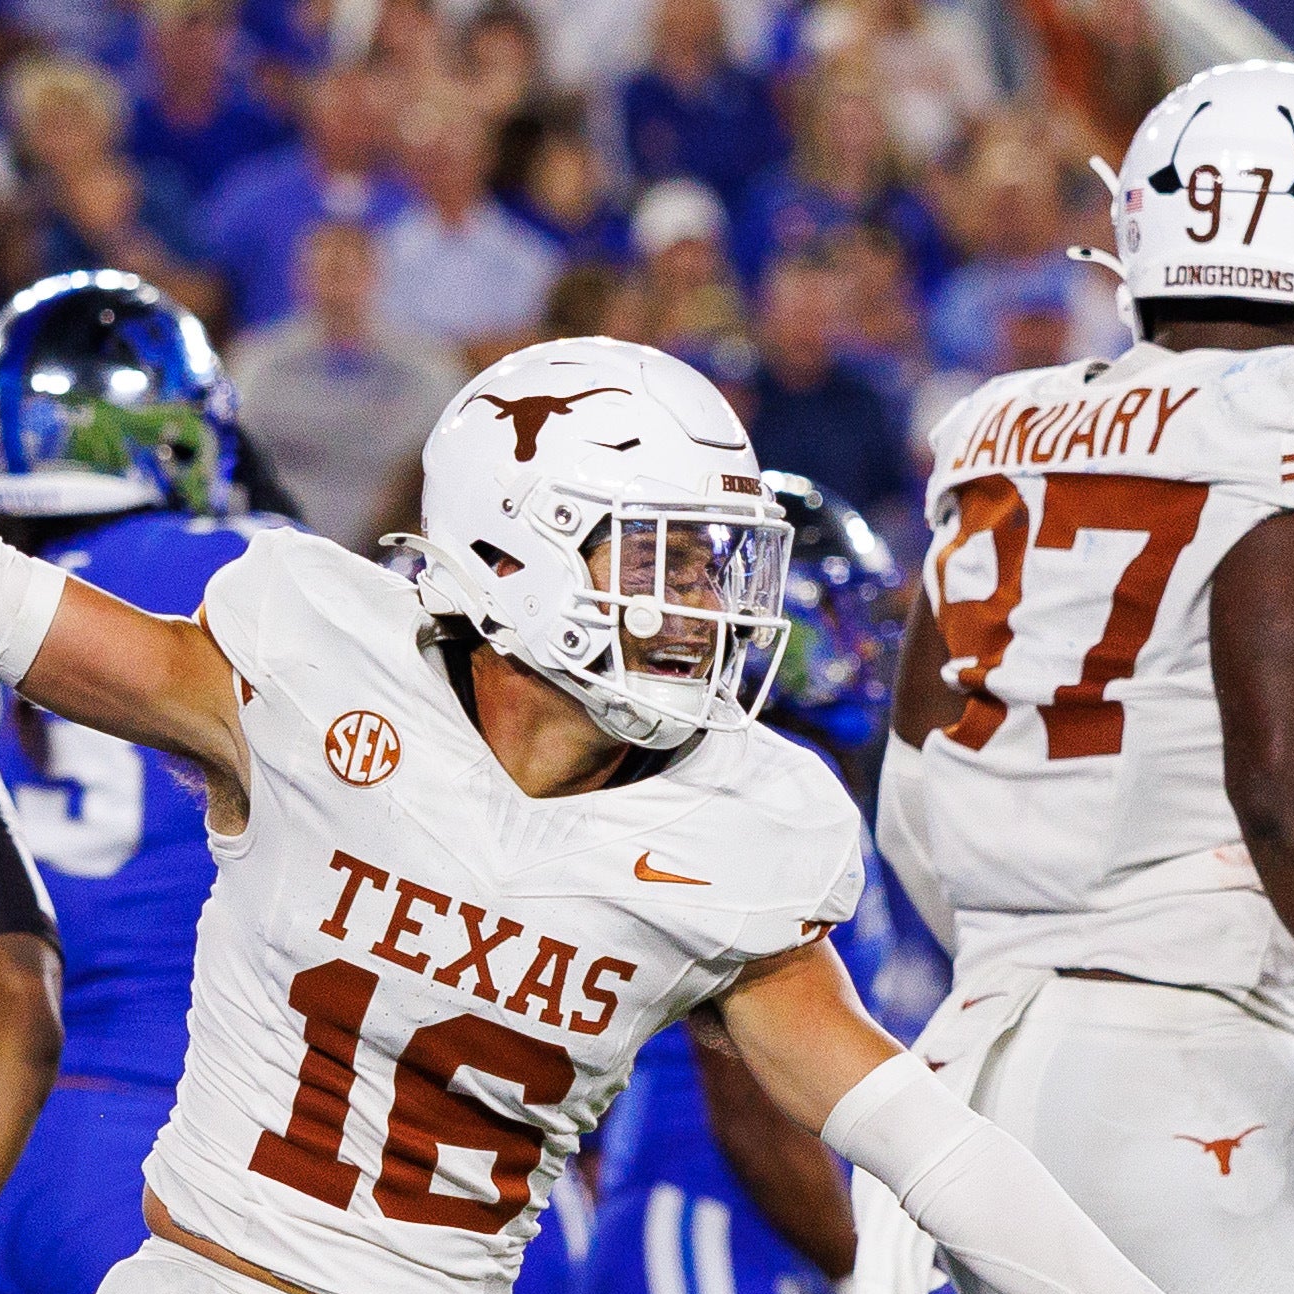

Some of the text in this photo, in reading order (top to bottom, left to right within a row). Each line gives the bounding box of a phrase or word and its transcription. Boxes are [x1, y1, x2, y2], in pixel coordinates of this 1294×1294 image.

[1185, 164, 1274, 246] 97
[1164, 264, 1294, 293] LONGHORNS
[953, 386, 1201, 470] JANUARY
[938, 471, 1210, 762] 97
[331, 716, 399, 783] SEC
[318, 849, 638, 1037] TEXAS
[247, 957, 577, 1235] 16
